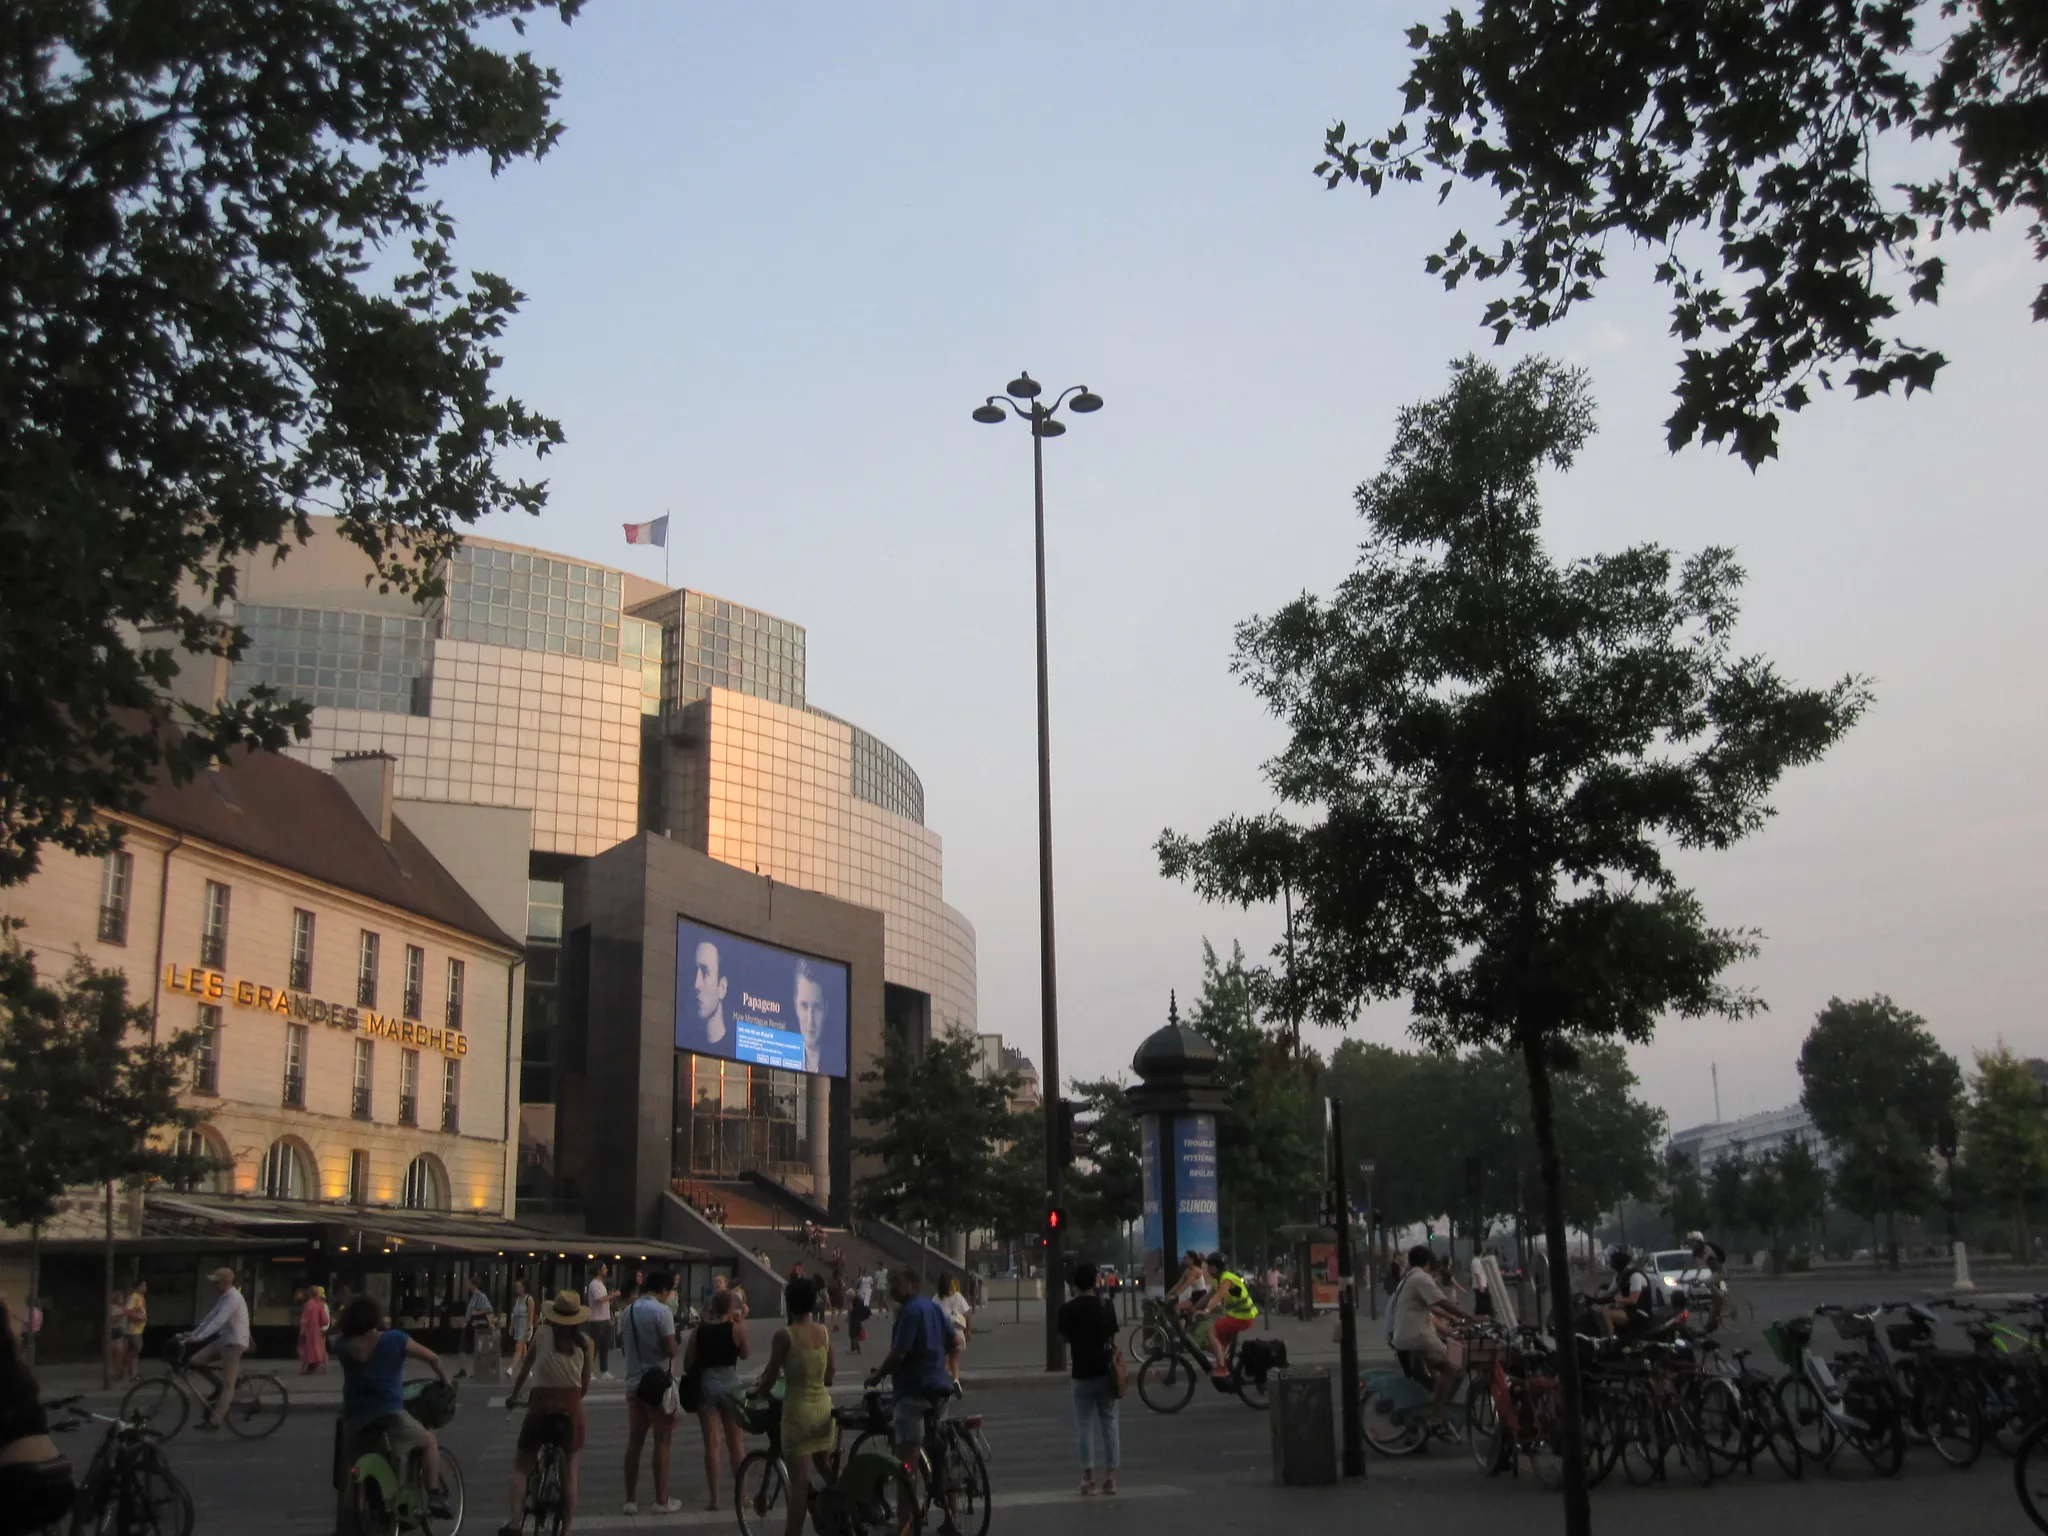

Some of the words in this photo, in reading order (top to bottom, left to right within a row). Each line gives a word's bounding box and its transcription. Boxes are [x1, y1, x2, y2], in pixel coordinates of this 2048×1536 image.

[169, 963, 224, 999] LES
[235, 979, 359, 1031] GRANDES
[367, 1012, 468, 1056] MARCHES
[742, 991, 781, 1014] Papageno
